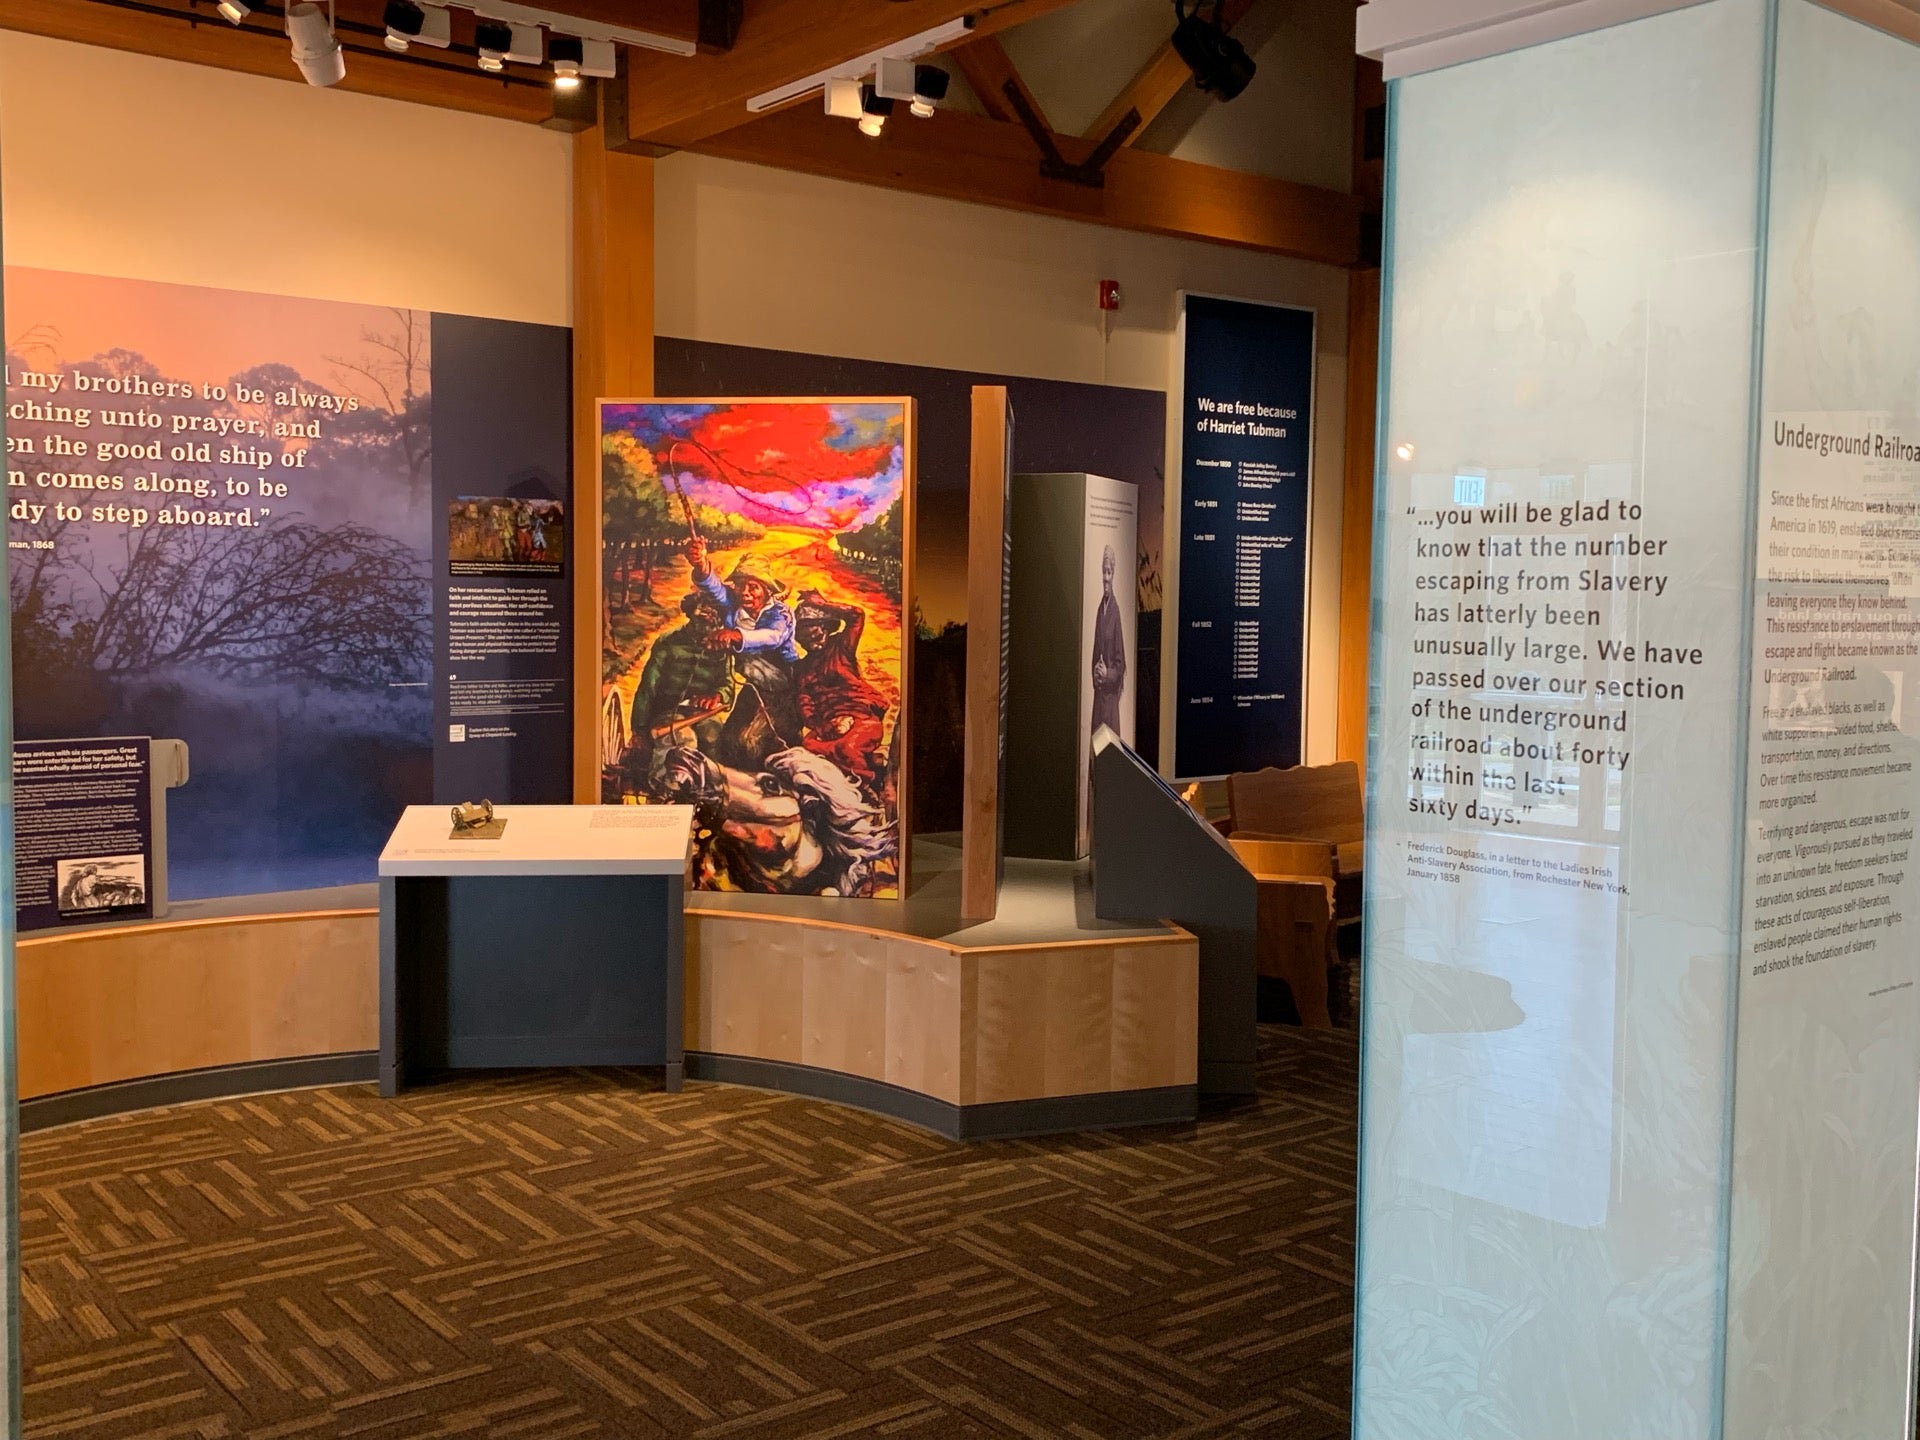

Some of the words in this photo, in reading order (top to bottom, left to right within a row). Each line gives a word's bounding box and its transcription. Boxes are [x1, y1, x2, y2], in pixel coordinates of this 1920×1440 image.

[21, 371, 64, 392] my
[73, 370, 193, 399] brothers
[202, 379, 227, 400] to
[236, 381, 265, 404] be
[275, 388, 359, 412] always
[6, 400, 91, 427] ching
[100, 407, 162, 429] unto
[172, 413, 265, 438] prayer,
[275, 420, 322, 439] and
[1198, 398, 1215, 412] We
[1217, 402, 1233, 413] are
[1235, 401, 1255, 415] free
[1257, 403, 1297, 419] because
[1197, 419, 1208, 431] of
[1210, 420, 1245, 435] Harriet
[1248, 422, 1286, 438] Tubman
[1774, 420, 1870, 457] Underground
[44, 435, 88, 456] the
[97, 441, 162, 462] good
[171, 443, 211, 463] old
[220, 448, 273, 470] ship
[281, 450, 306, 468] of
[36, 472, 124, 490] comes
[134, 472, 217, 498] along,
[226, 480, 250, 496] to
[259, 478, 288, 497] be
[8, 499, 46, 523] dy
[55, 503, 82, 521] to
[92, 505, 148, 527] step
[1480, 503, 1517, 524] will
[1526, 505, 1552, 522] be
[1560, 500, 1609, 526] glad
[1619, 501, 1642, 521] to
[1771, 491, 1794, 506] Since
[1796, 493, 1810, 508] the
[1812, 494, 1828, 510] first
[1831, 496, 1864, 512] Africans
[1770, 517, 1806, 532] America
[1808, 519, 1815, 532] in
[1818, 520, 1838, 537] 1619,
[32, 540, 54, 549] 1868
[1417, 538, 1470, 558] know
[1478, 536, 1522, 557] that
[1531, 536, 1567, 556] the
[1575, 534, 1668, 556] number
[1416, 570, 1509, 594] escaping
[1518, 570, 1569, 590] from
[1579, 570, 1668, 596] Slavery
[1767, 592, 1797, 610] leaving
[1800, 596, 1837, 611] everyone
[1839, 594, 1855, 611] they
[1858, 594, 1878, 609] know
[1415, 602, 1449, 622] has
[1457, 603, 1537, 628] latterly
[1545, 604, 1600, 626] been
[1767, 618, 1785, 633] This
[1787, 620, 1829, 633] resistance
[1831, 621, 1839, 632] to
[1841, 620, 1889, 632] enslavement
[1414, 637, 1515, 661] unusually
[1524, 637, 1588, 663] large.
[1597, 639, 1636, 662] We
[1644, 641, 1703, 665] have
[1765, 647, 1795, 660] escape
[1797, 643, 1812, 657] and
[1814, 642, 1835, 660] flight
[1838, 642, 1868, 656] became
[1870, 642, 1894, 656] known
[1896, 645, 1904, 655] as
[1906, 643, 1918, 655] the
[1413, 669, 1485, 690] passed
[1493, 675, 1541, 692] over
[1549, 677, 1586, 694] our
[1594, 676, 1684, 700] section
[1412, 699, 1432, 717] of
[1439, 700, 1472, 721] the
[1480, 703, 1626, 732] underground
[1410, 732, 1492, 755] railroad
[1500, 737, 1564, 762] about
[1572, 742, 1630, 771] forty
[1410, 763, 1474, 786] within
[1482, 767, 1516, 790] the
[1525, 772, 1566, 796] last
[1409, 796, 1457, 820] sixty
[1758, 825, 1794, 840] Terrifying
[1795, 822, 1808, 835] and
[1810, 818, 1848, 835] dangerous,
[1408, 841, 1444, 853] Frederick
[1446, 847, 1487, 861] Douglass,
[1489, 852, 1497, 862] in
[1506, 855, 1529, 866] letter
[1532, 858, 1541, 867] to
[1544, 859, 1558, 870] the
[1560, 862, 1589, 874] Ladies
[1592, 866, 1612, 877] Irish
[1407, 867, 1438, 881] January
[1440, 872, 1460, 883] 1858
[1408, 854, 1457, 871] Anti-Slavery
[1459, 862, 1510, 878] Association,
[1513, 869, 1534, 880] from
[1536, 873, 1580, 887] Rochester
[1583, 880, 1603, 891] New
[1755, 917, 1775, 931] these
[1777, 914, 1792, 926] acts
[1794, 909, 1801, 922] of
[1802, 905, 1842, 920] courageous
[1754, 934, 1786, 953] enslaved
[1788, 929, 1812, 948] people
[1814, 923, 1841, 940] claimed
[1842, 921, 1857, 934] their
[1860, 916, 1882, 930] human
[1883, 912, 1902, 927] rights
[1753, 960, 1767, 976] and
[1769, 955, 1790, 973] shook
[1792, 952, 1803, 966] the
[1806, 945, 1843, 963] foundation
[1844, 941, 1851, 953] of
[1853, 939, 1877, 952] slavery.
